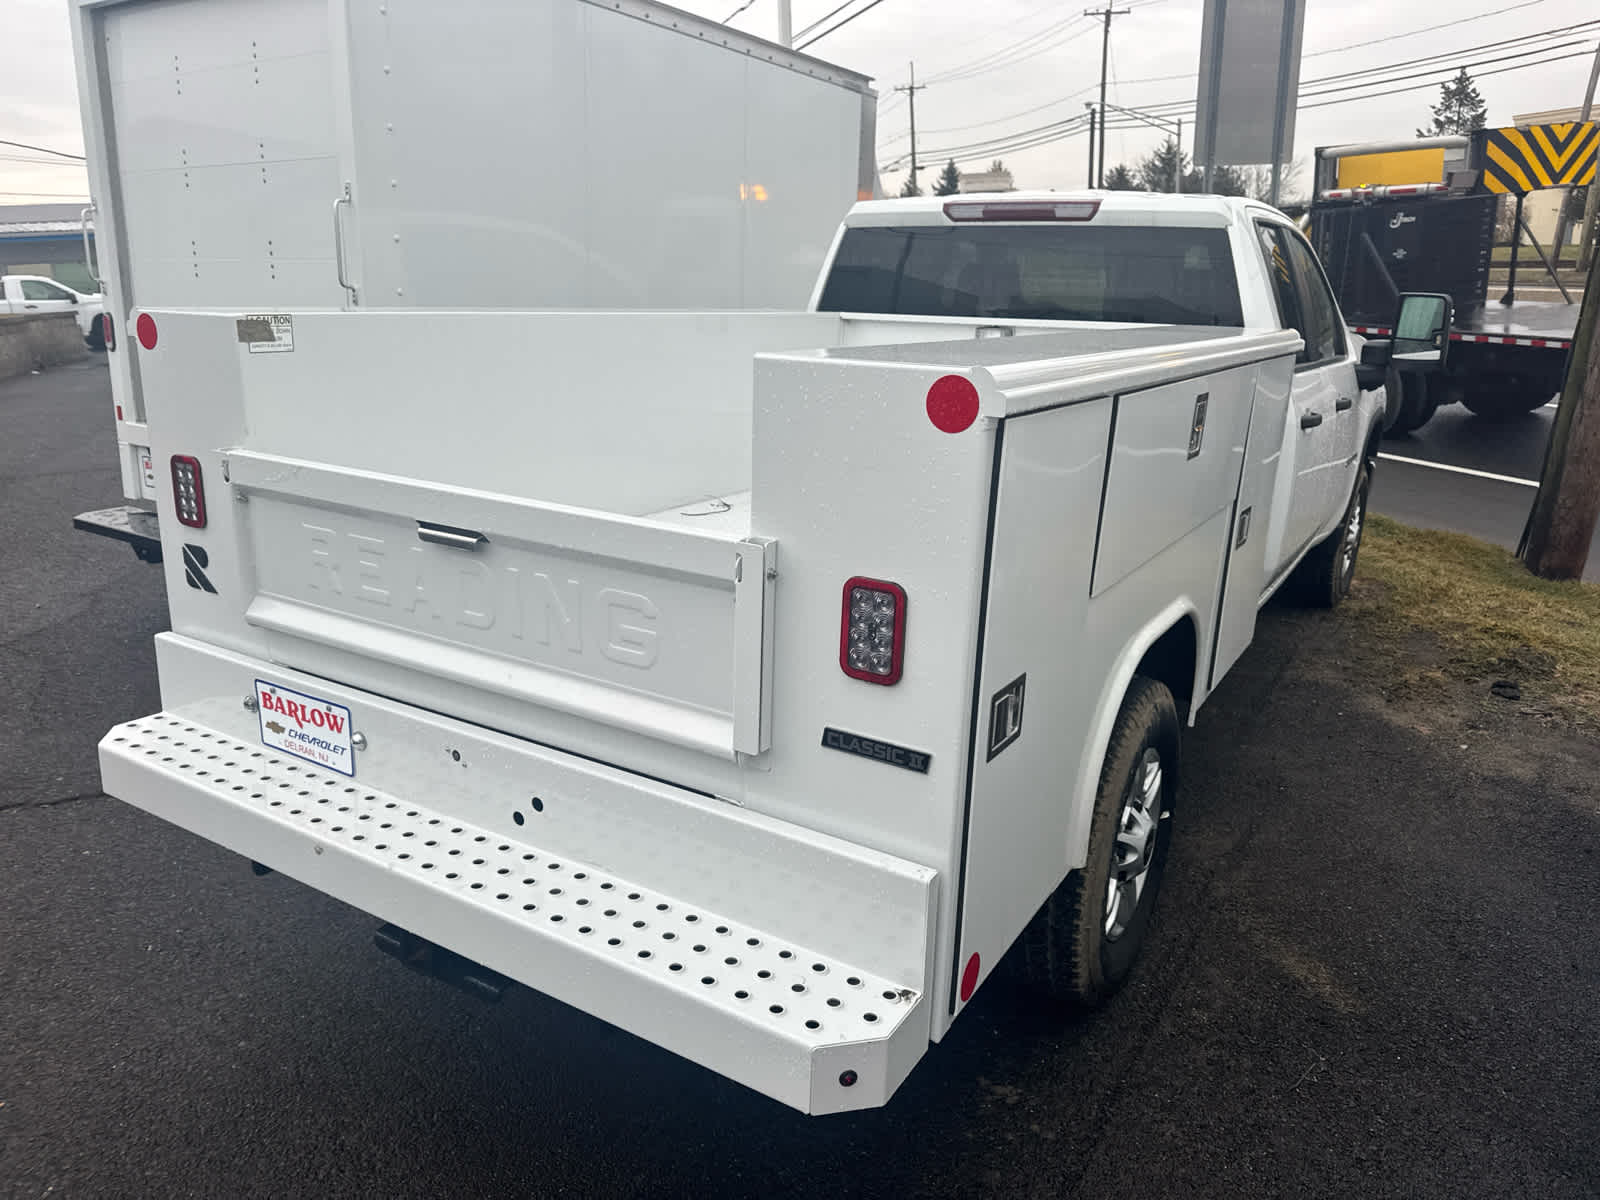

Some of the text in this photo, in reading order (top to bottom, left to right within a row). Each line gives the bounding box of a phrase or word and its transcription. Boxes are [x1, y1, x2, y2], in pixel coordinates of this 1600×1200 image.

[301, 522, 662, 670] READING
[261, 691, 345, 734] BARLOW
[288, 729, 347, 756] CHEVROLET
[826, 731, 905, 764] CLASSIC
